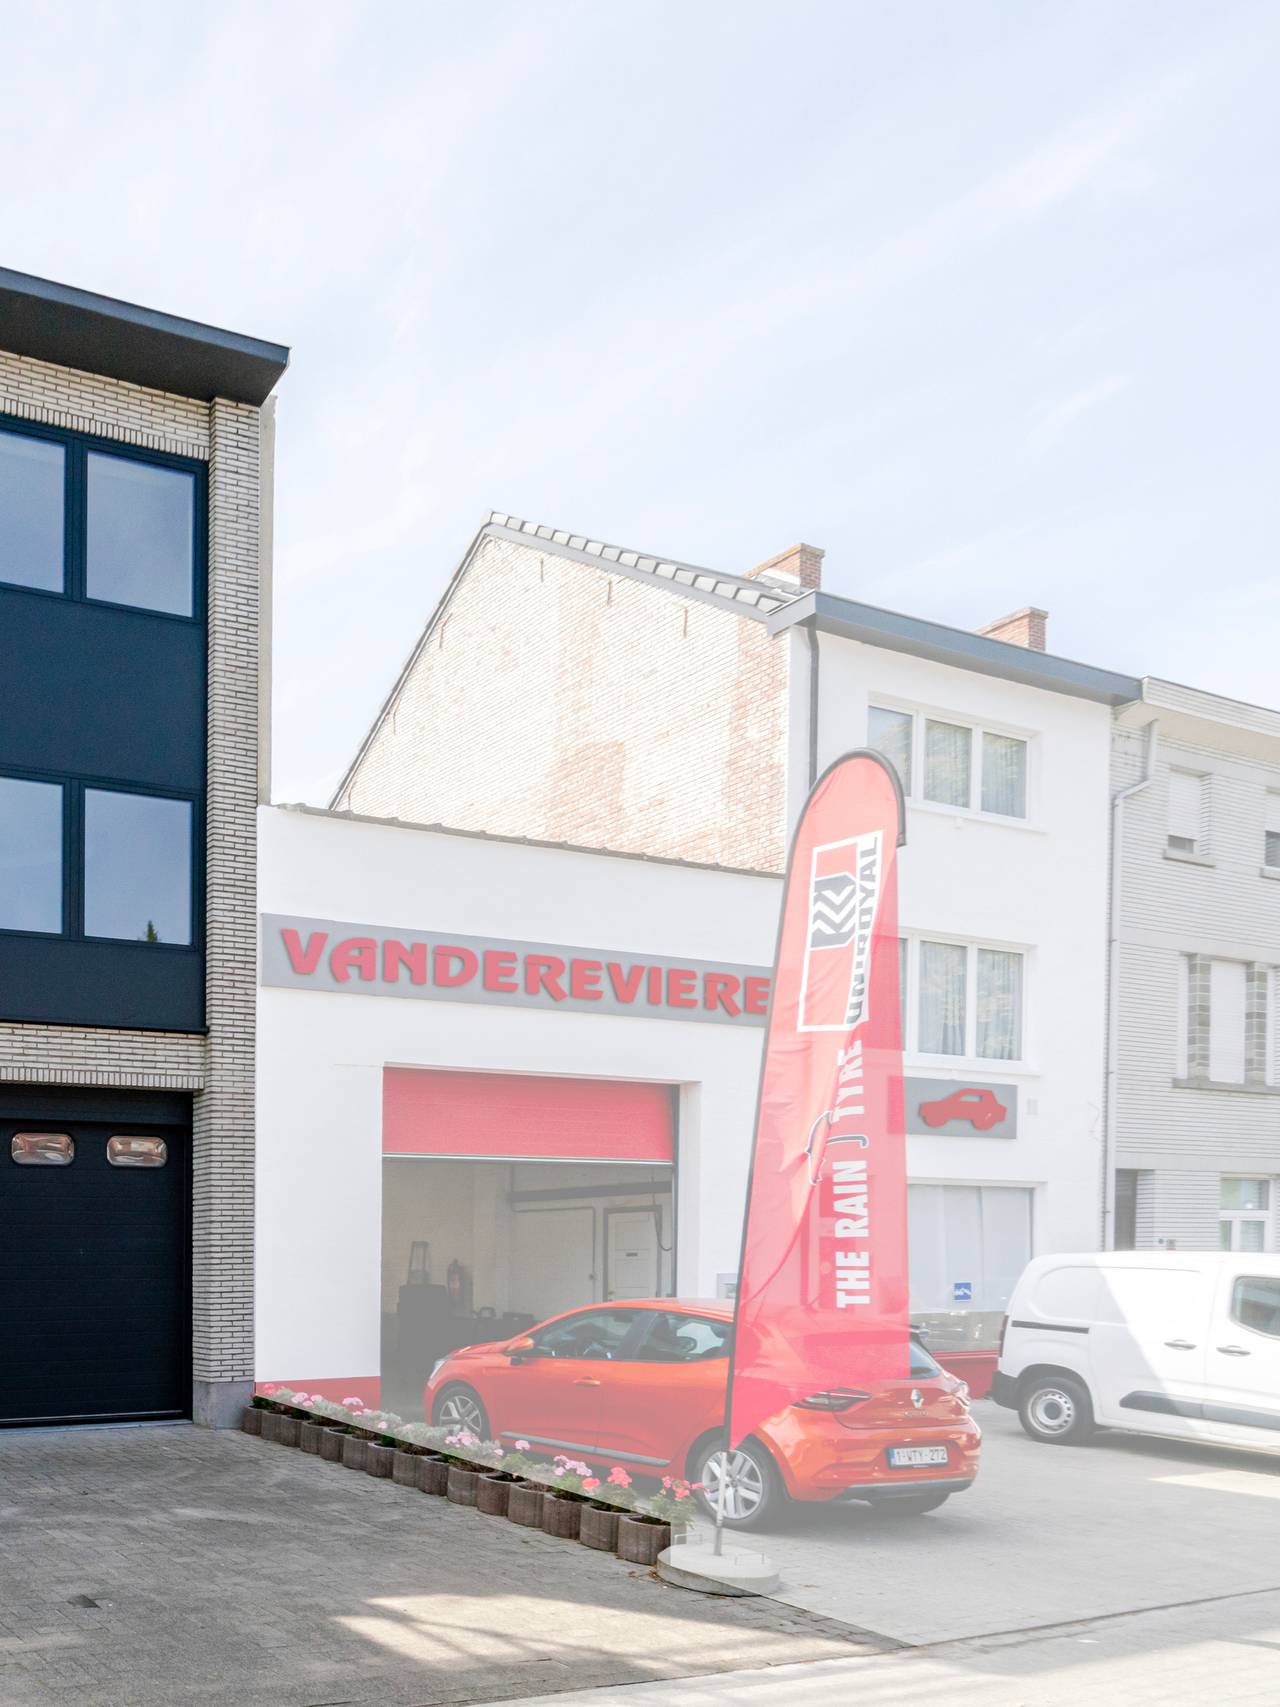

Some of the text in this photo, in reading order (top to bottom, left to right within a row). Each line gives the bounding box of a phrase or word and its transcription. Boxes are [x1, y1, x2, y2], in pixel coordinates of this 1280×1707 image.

[279, 927, 772, 1018] VANDEREVIERE
[845, 836, 878, 1025] UNIROYAL
[831, 1160, 870, 1239] RAIN
[835, 1251, 871, 1309] THE
